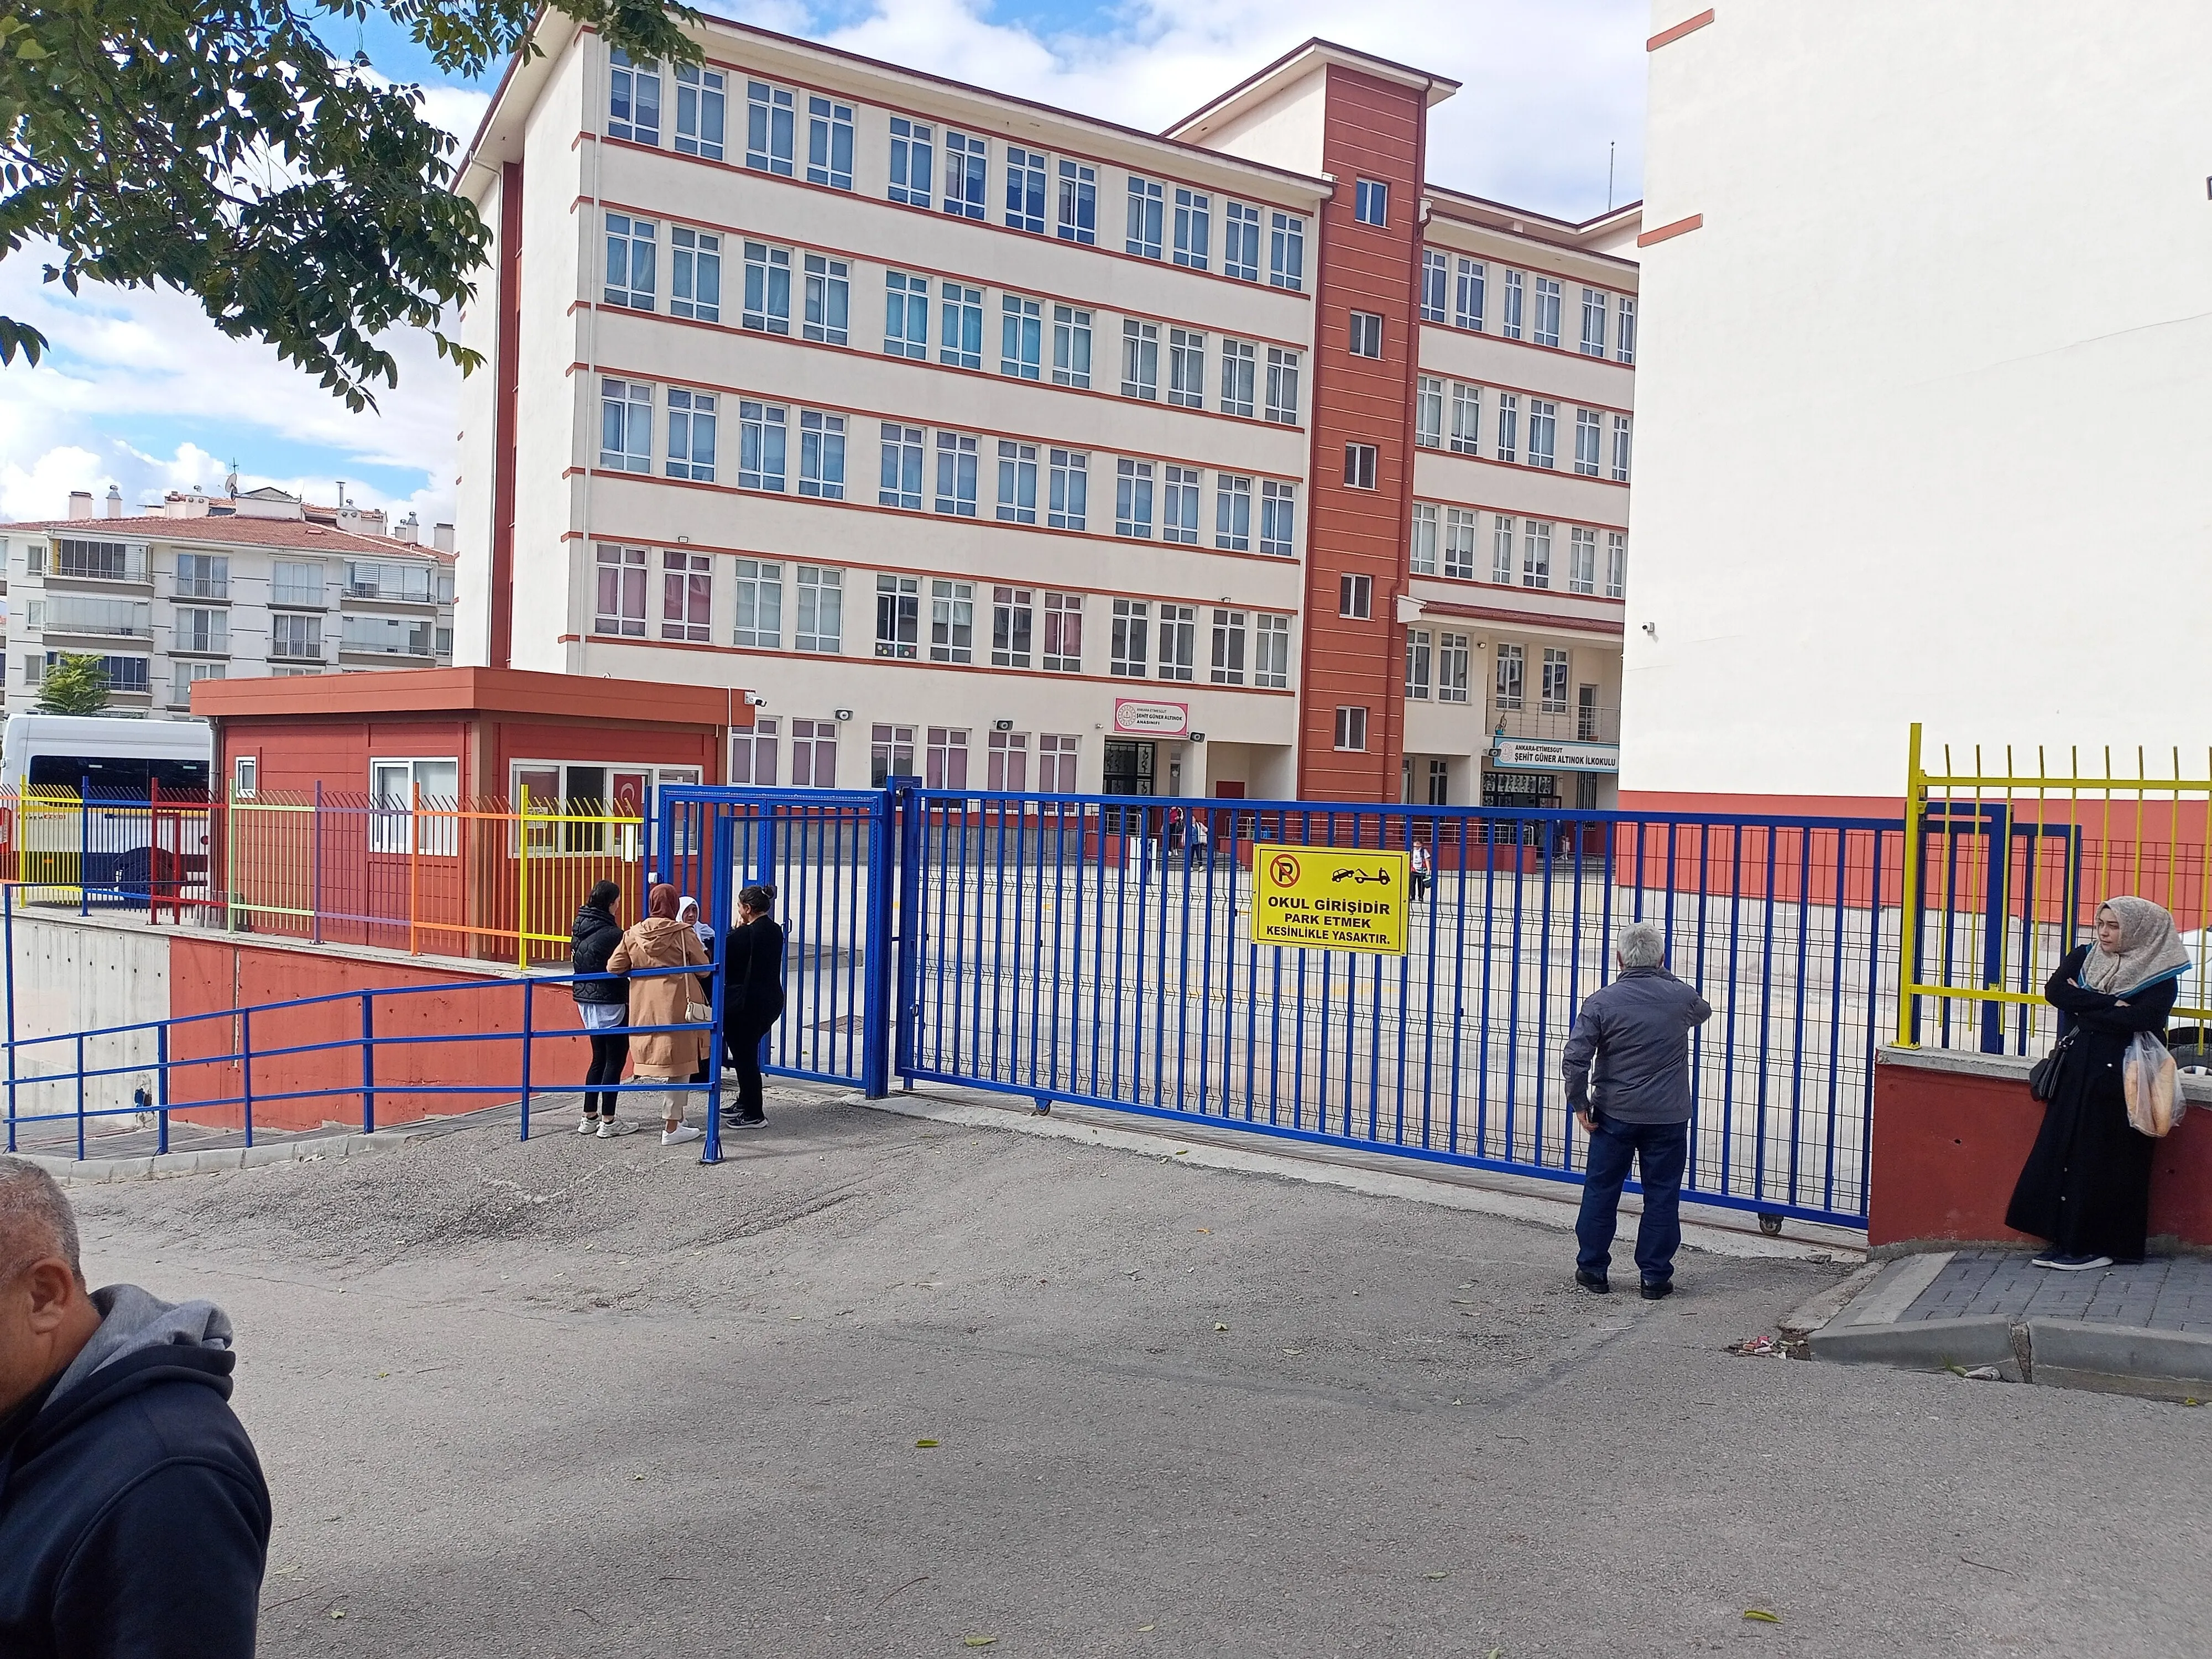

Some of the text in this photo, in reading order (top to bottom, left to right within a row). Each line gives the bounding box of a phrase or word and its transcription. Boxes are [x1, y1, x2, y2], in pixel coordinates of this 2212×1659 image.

[1515, 744, 1563, 753] ANKARA-ETİMESGUT
[1515, 752, 1616, 766] ŞEHİT GÜNER ALTINOK İLKOKULU
[1268, 896, 1390, 915] OKUL GİRİŞİDİR
[1285, 913, 1371, 928] PARK ETMEK
[1266, 925, 1390, 945] KESİNLİKLE YASAKTIR.
